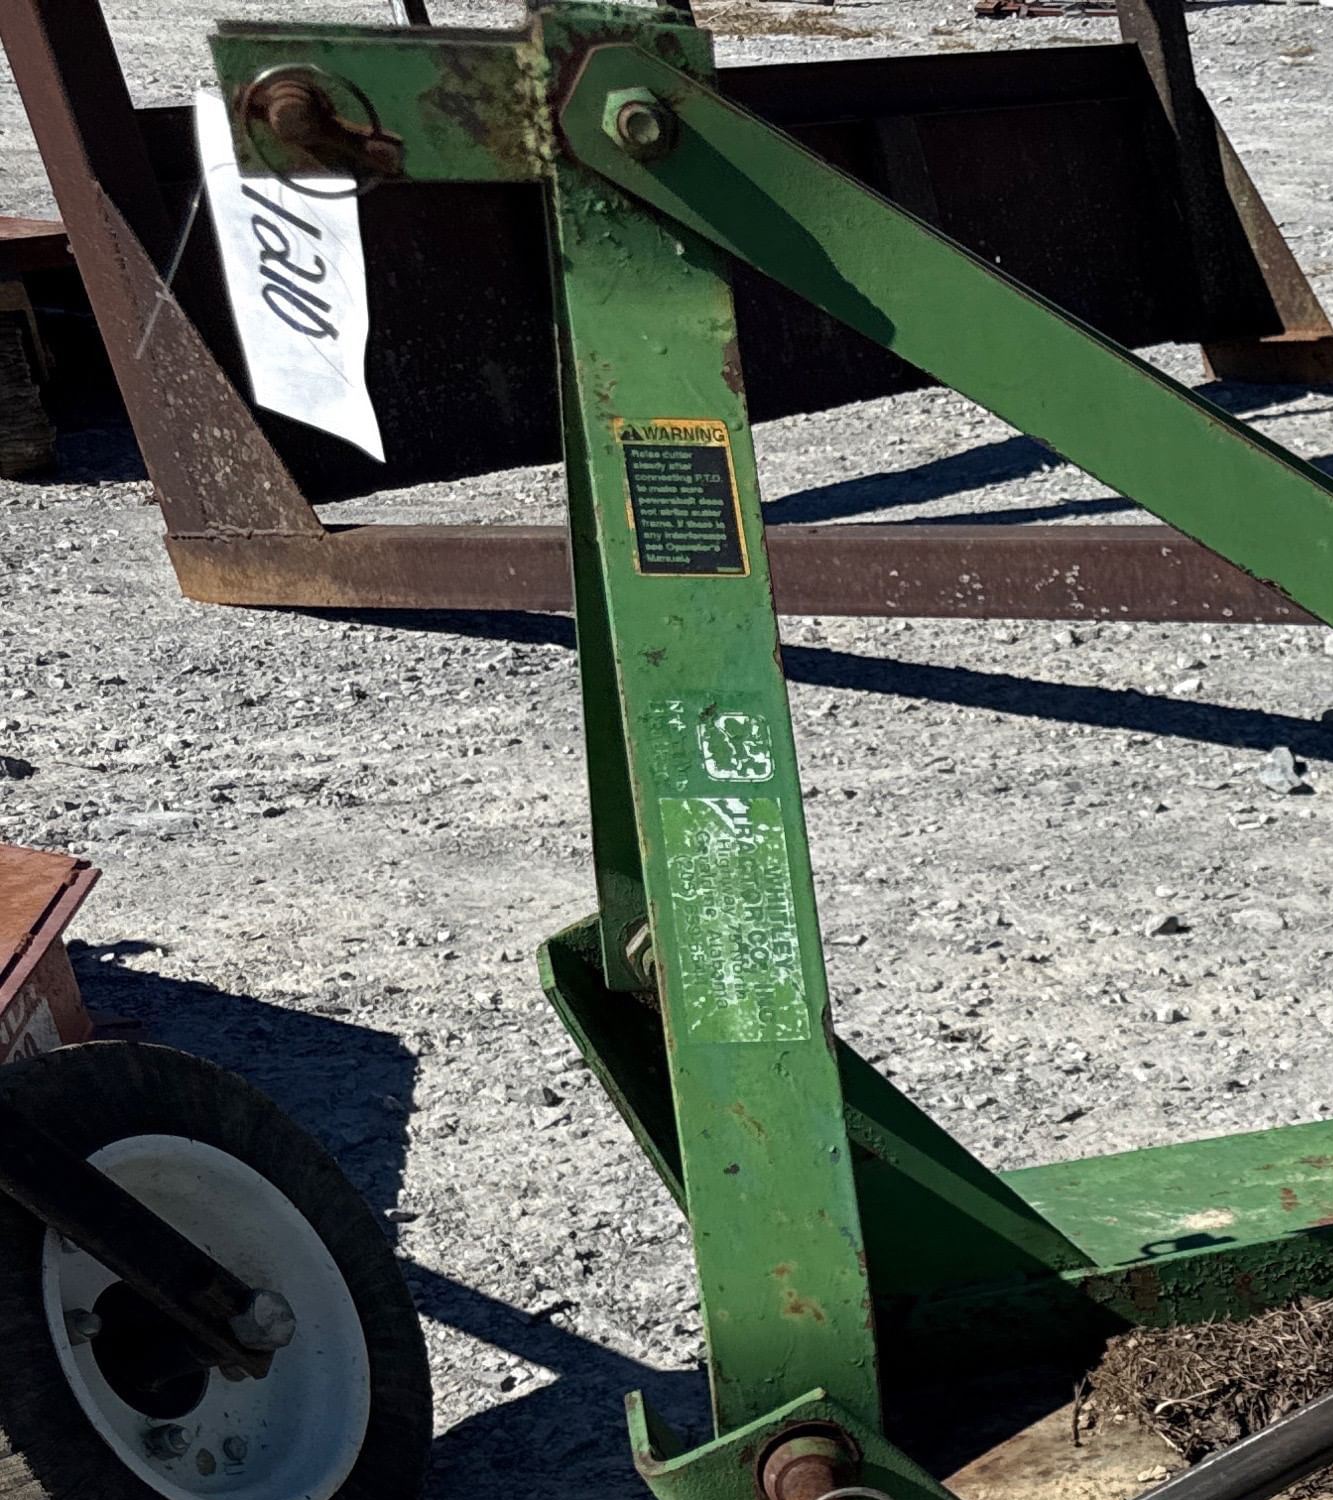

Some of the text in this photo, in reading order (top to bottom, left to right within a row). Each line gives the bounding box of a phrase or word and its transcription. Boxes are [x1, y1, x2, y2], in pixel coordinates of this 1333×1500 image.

[241, 183, 340, 340] 1210
[634, 473, 693, 483] connecting
[644, 427, 725, 442] WARNING
[712, 837, 740, 916] Highway
[729, 950, 749, 1000] North
[731, 810, 765, 922] TRACTOR
[763, 865, 794, 970] WHITLEY
[705, 928, 730, 1010] Alabama
